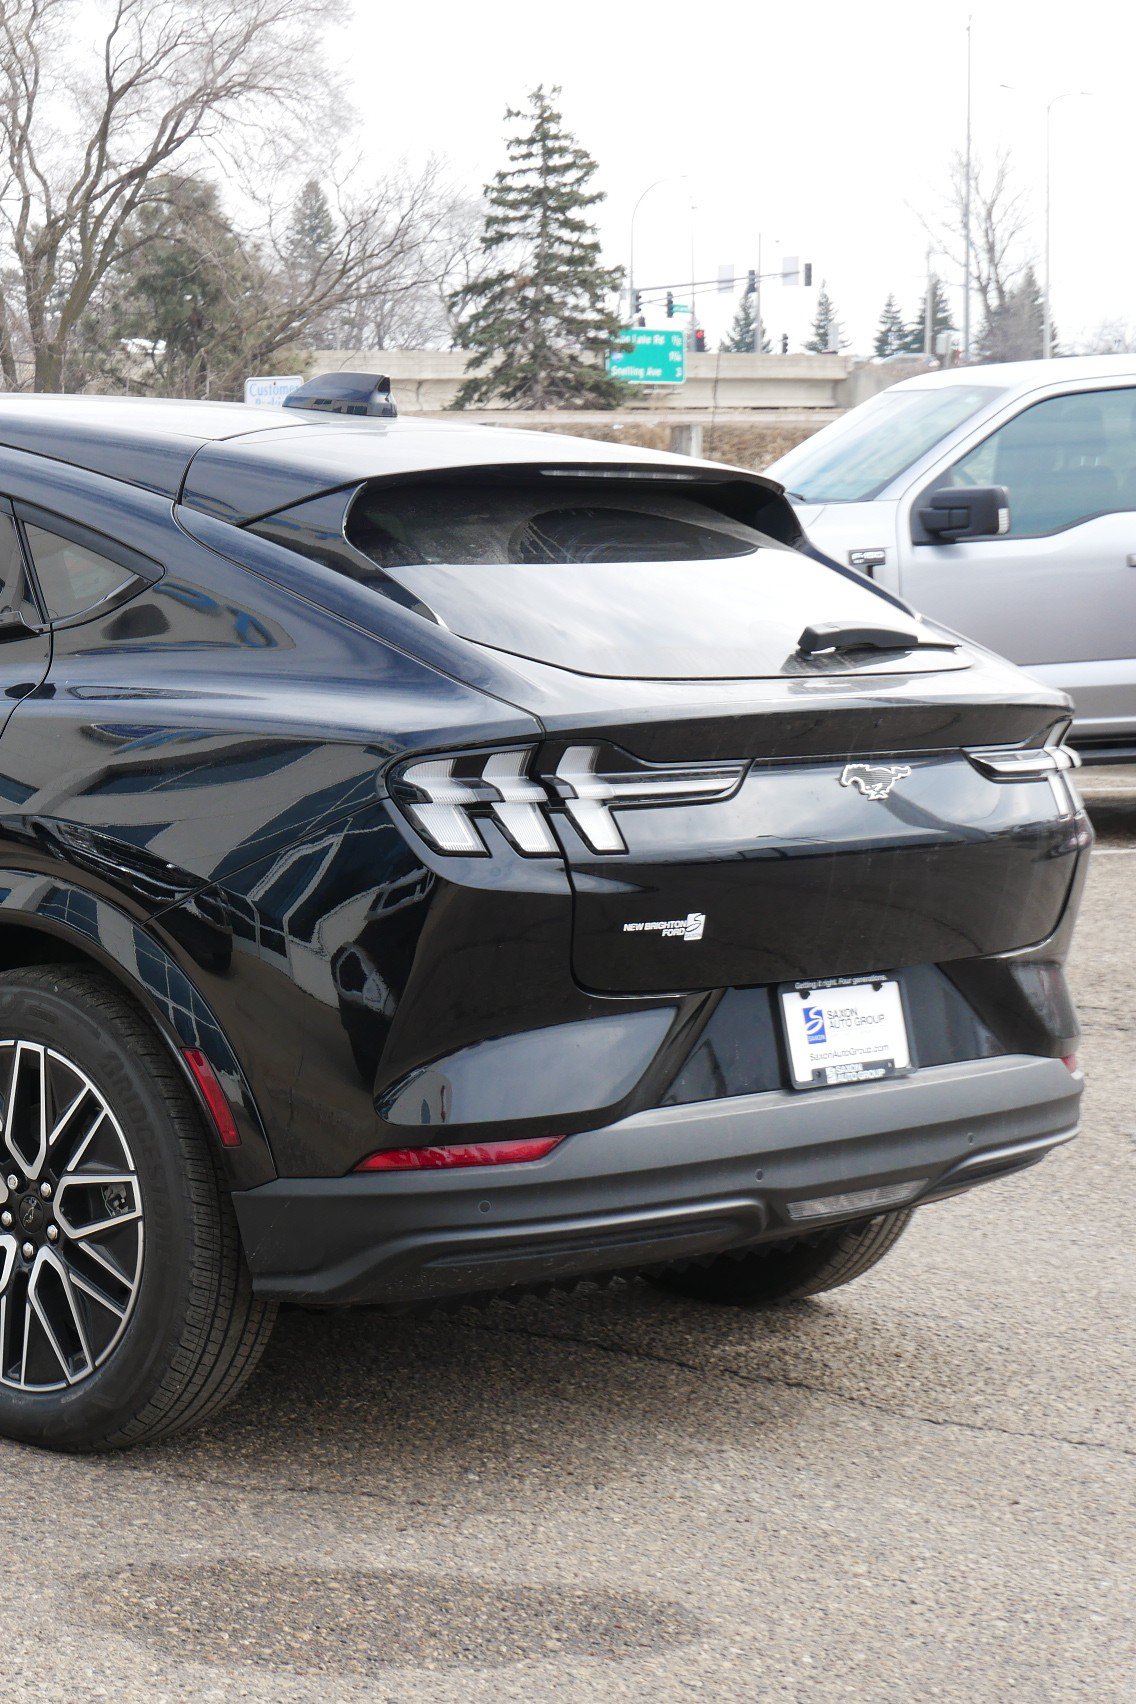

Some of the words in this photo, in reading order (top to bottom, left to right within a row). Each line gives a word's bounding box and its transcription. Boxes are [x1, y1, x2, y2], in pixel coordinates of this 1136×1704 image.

[652, 334, 666, 346] Rd
[646, 366, 663, 377] Ave
[623, 923, 645, 932] NEW
[644, 919, 687, 930] BRIGHTON
[661, 928, 686, 937] FORD
[827, 1007, 858, 1020] SAXON
[830, 1018, 853, 1029] AUTO
[854, 1014, 885, 1027] GROUP
[809, 1044, 889, 1061] SaxonAutoGroup.com
[836, 1062, 863, 1074] SAXON
